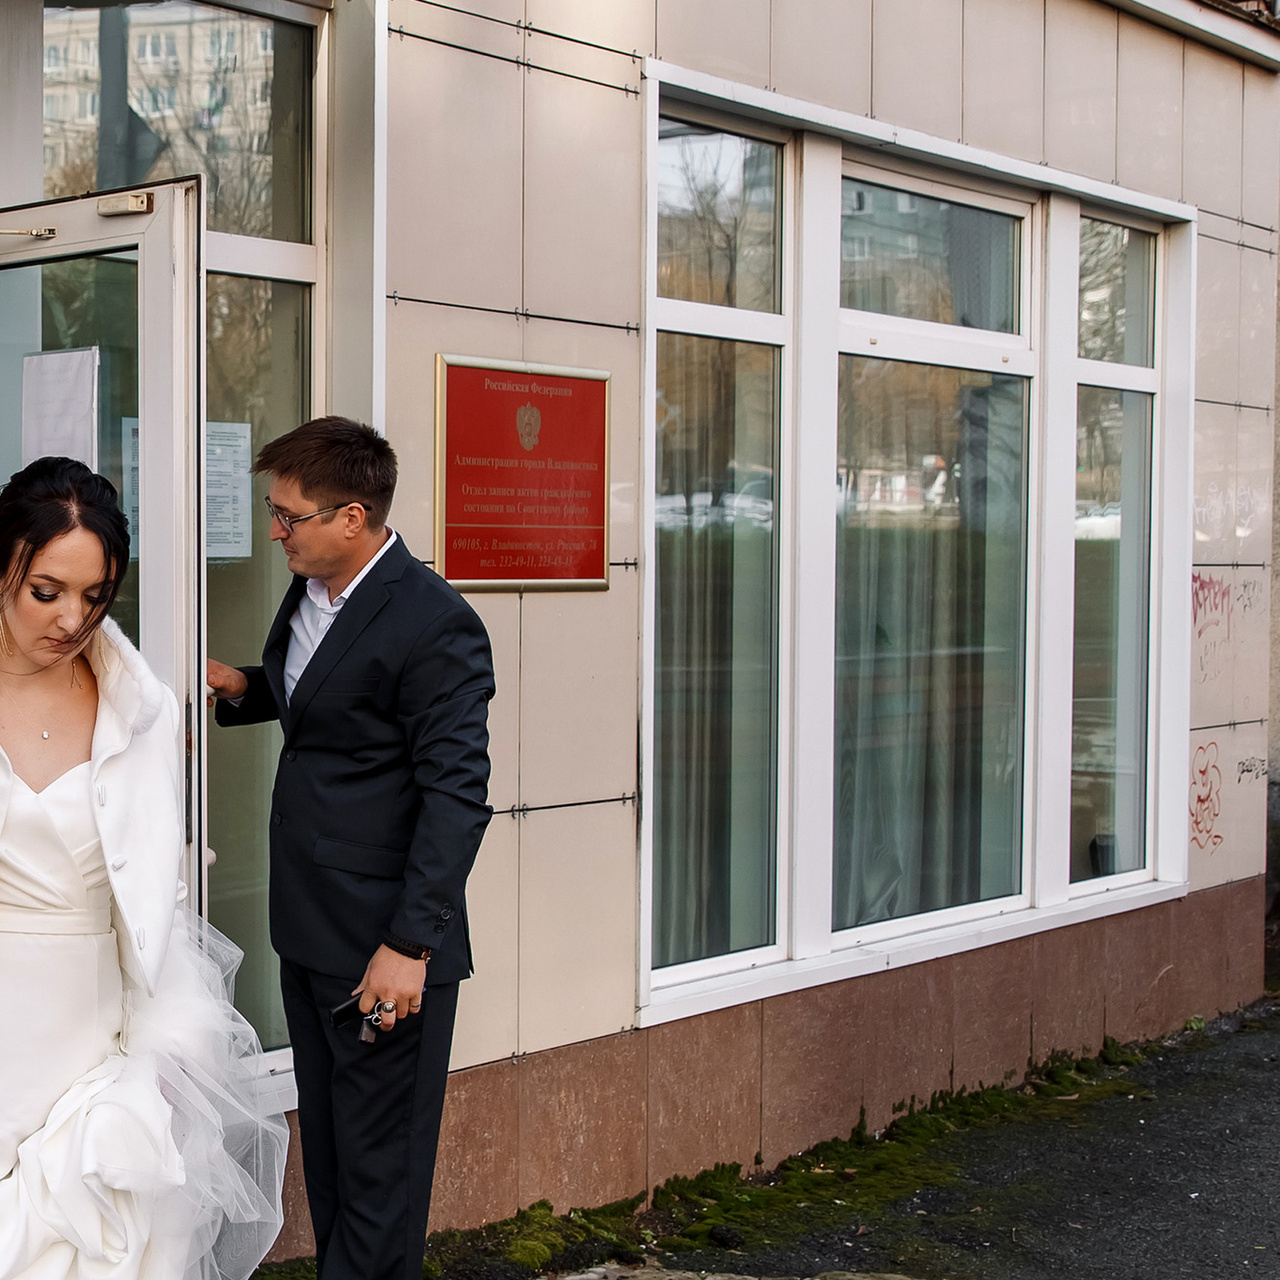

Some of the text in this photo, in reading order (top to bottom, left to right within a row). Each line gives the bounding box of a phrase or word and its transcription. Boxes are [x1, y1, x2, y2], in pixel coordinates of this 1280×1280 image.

[484, 377, 573, 398] Российская Федерация
[454, 454, 599, 472] Администрация города Владивостока
[461, 483, 592, 501] Отдел записи актов гражданского
[463, 503, 505, 513] состояния
[506, 504, 516, 513] по
[517, 502, 561, 516] Советскому
